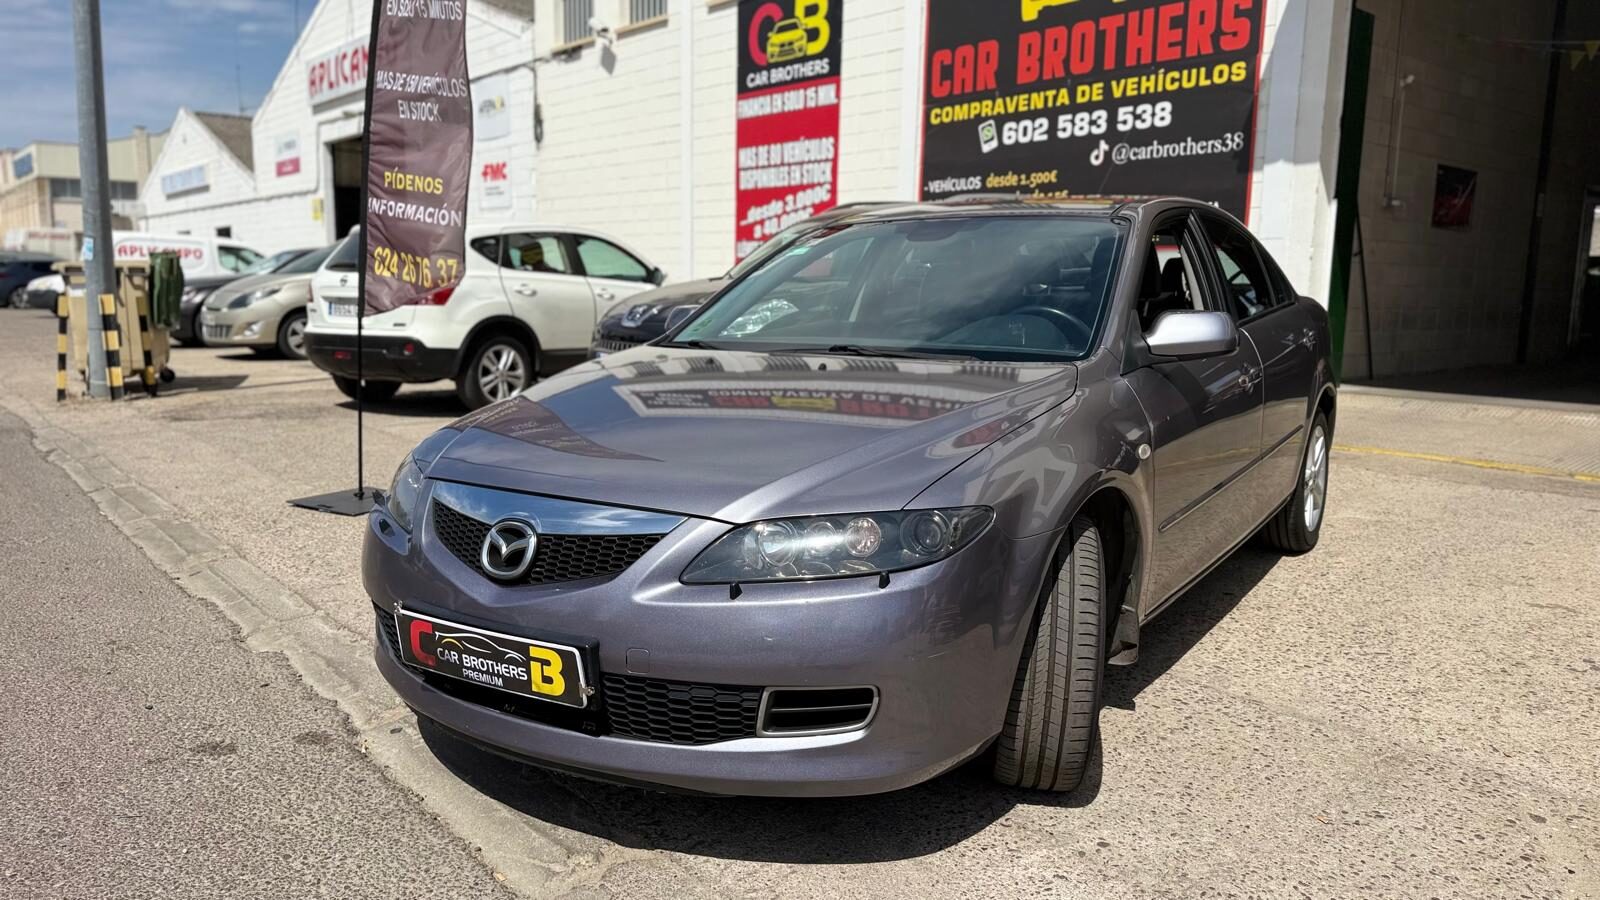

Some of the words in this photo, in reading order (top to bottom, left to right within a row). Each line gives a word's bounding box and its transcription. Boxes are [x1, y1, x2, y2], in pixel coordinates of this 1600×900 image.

[929, 39, 1000, 98] CAR
[1016, 0, 1253, 85] BROTHERS
[394, 73, 406, 92] DE
[746, 70, 769, 88] CAR
[770, 58, 830, 84] BROTHERS
[930, 86, 1070, 125] COMPRAVENTA
[1075, 82, 1104, 104] DE
[1111, 61, 1248, 99] VEHÍCULOS
[398, 100, 411, 119] EN
[411, 102, 442, 123] STOCK
[1002, 117, 1049, 145] 602
[1056, 108, 1108, 139] 583
[1116, 100, 1173, 131] 538
[1111, 131, 1245, 166] @carbrothers38
[384, 166, 443, 195] PÍDENOS
[802, 161, 832, 186] STOCK
[985, 172, 1018, 188] desde
[1020, 170, 1058, 188] 1.500€
[368, 197, 463, 227] INFORMACIÓN
[374, 246, 399, 278] 624
[401, 252, 416, 284] 26
[416, 256, 433, 288] 76
[437, 257, 458, 288] 37
[436, 647, 460, 665] CAR
[462, 654, 528, 681] BROTHERS
[462, 668, 504, 687] PREMIUM
